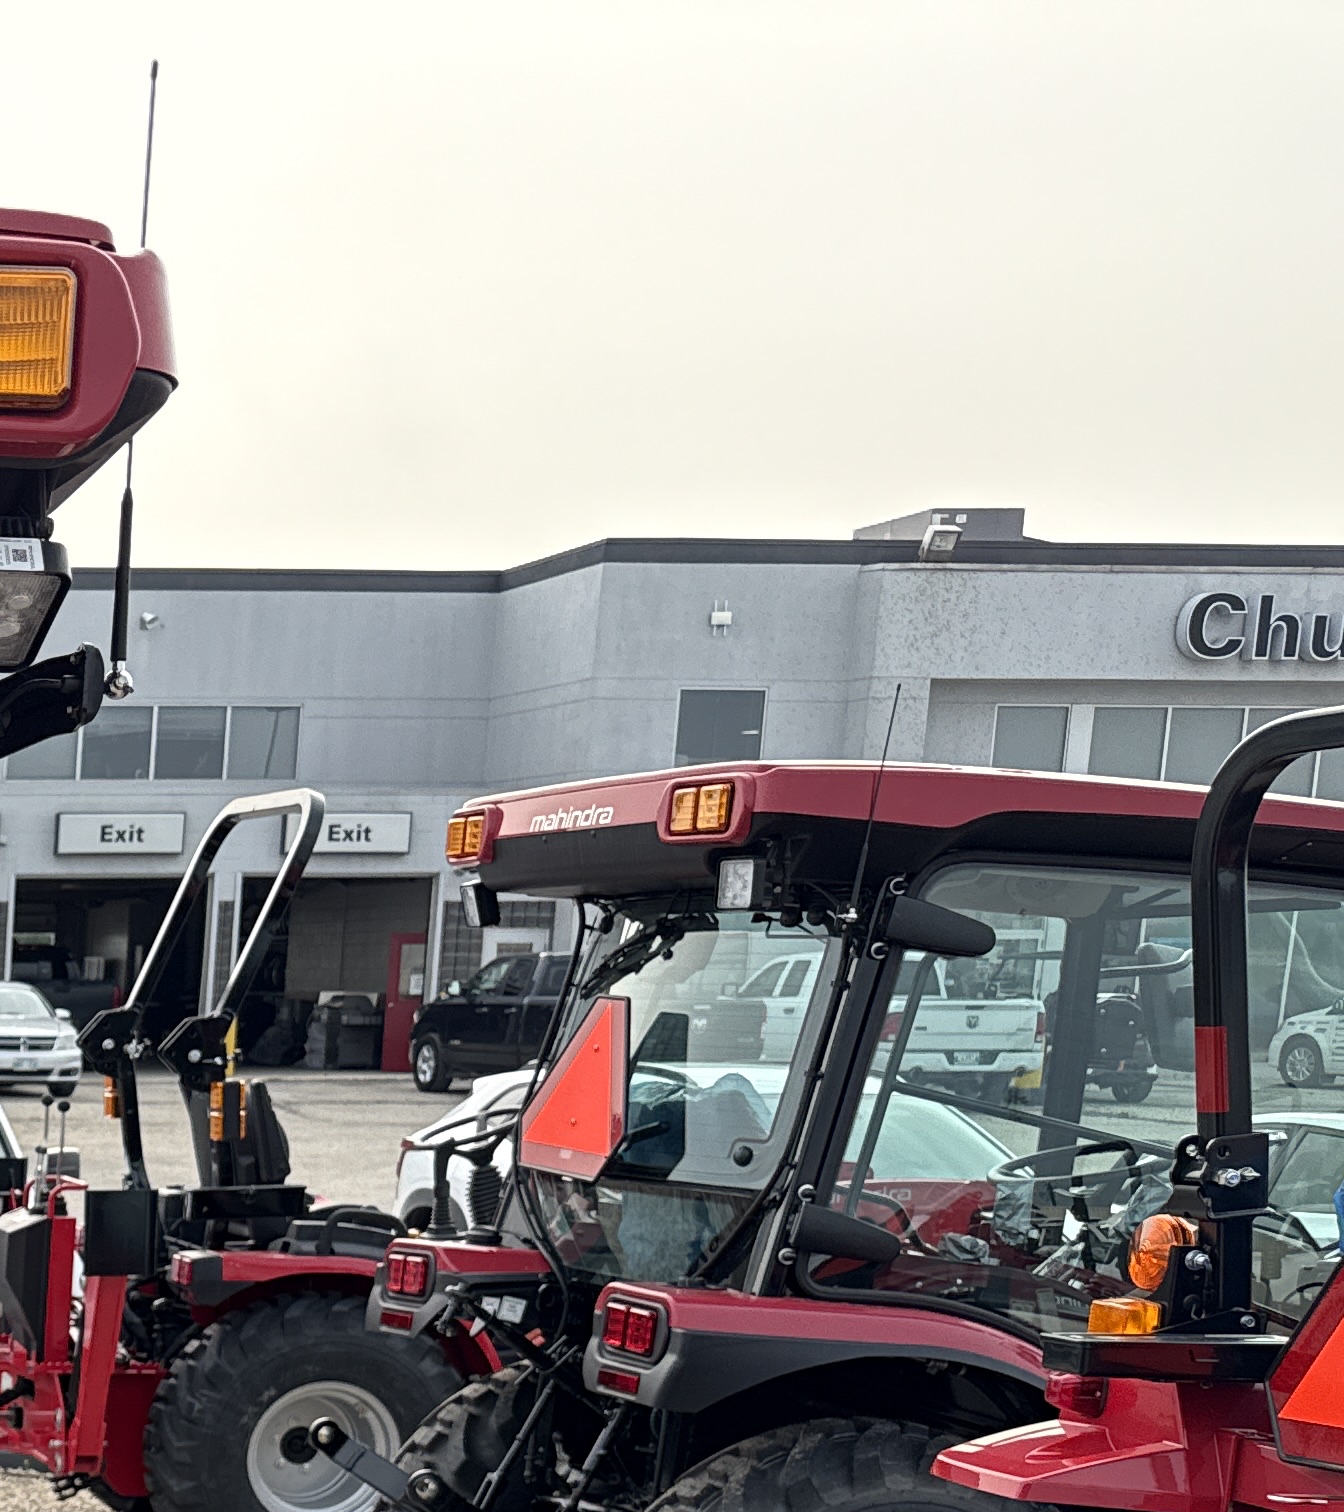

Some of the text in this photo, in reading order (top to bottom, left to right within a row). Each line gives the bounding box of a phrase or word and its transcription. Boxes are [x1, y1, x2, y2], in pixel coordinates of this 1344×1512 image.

[528, 803, 614, 832] mahindra
[100, 824, 145, 843] Exit
[327, 824, 372, 843] Exit
